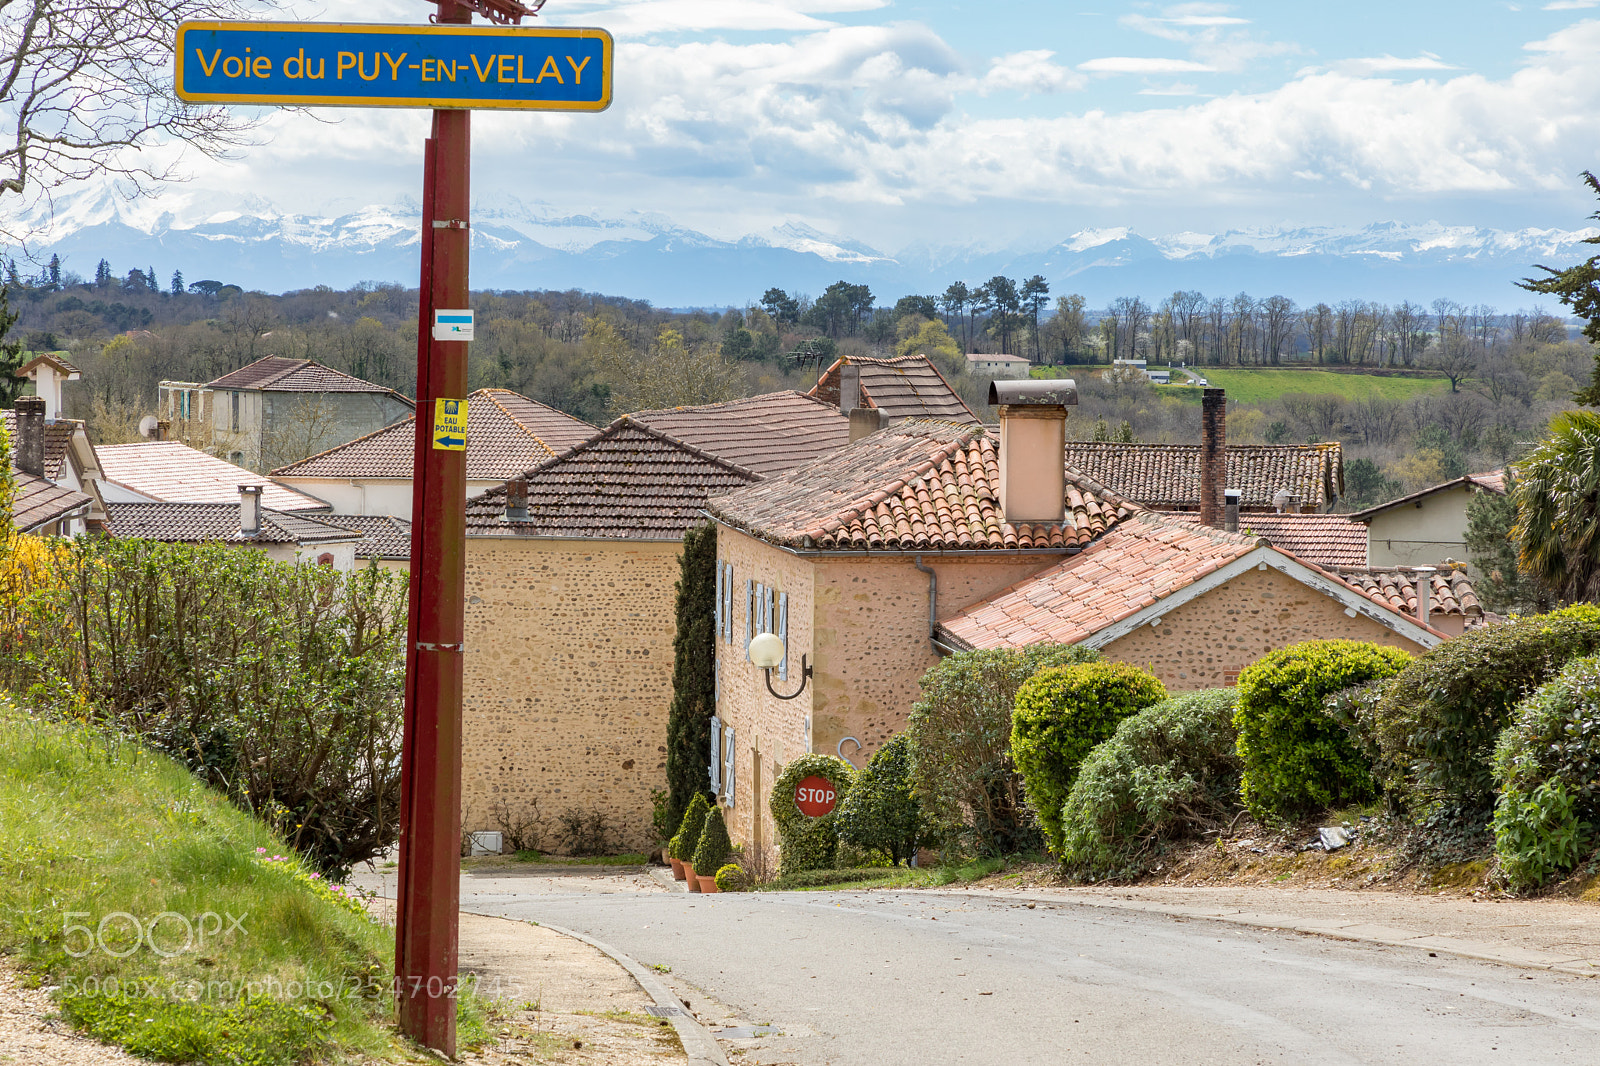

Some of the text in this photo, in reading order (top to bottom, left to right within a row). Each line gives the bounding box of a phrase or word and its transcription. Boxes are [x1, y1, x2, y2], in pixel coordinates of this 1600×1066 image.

[195, 47, 591, 85] Voie du PUY-EN-VELAY
[444, 417, 458, 425] EAU
[435, 424, 465, 434] POTABLE
[798, 787, 835, 804] STOP
